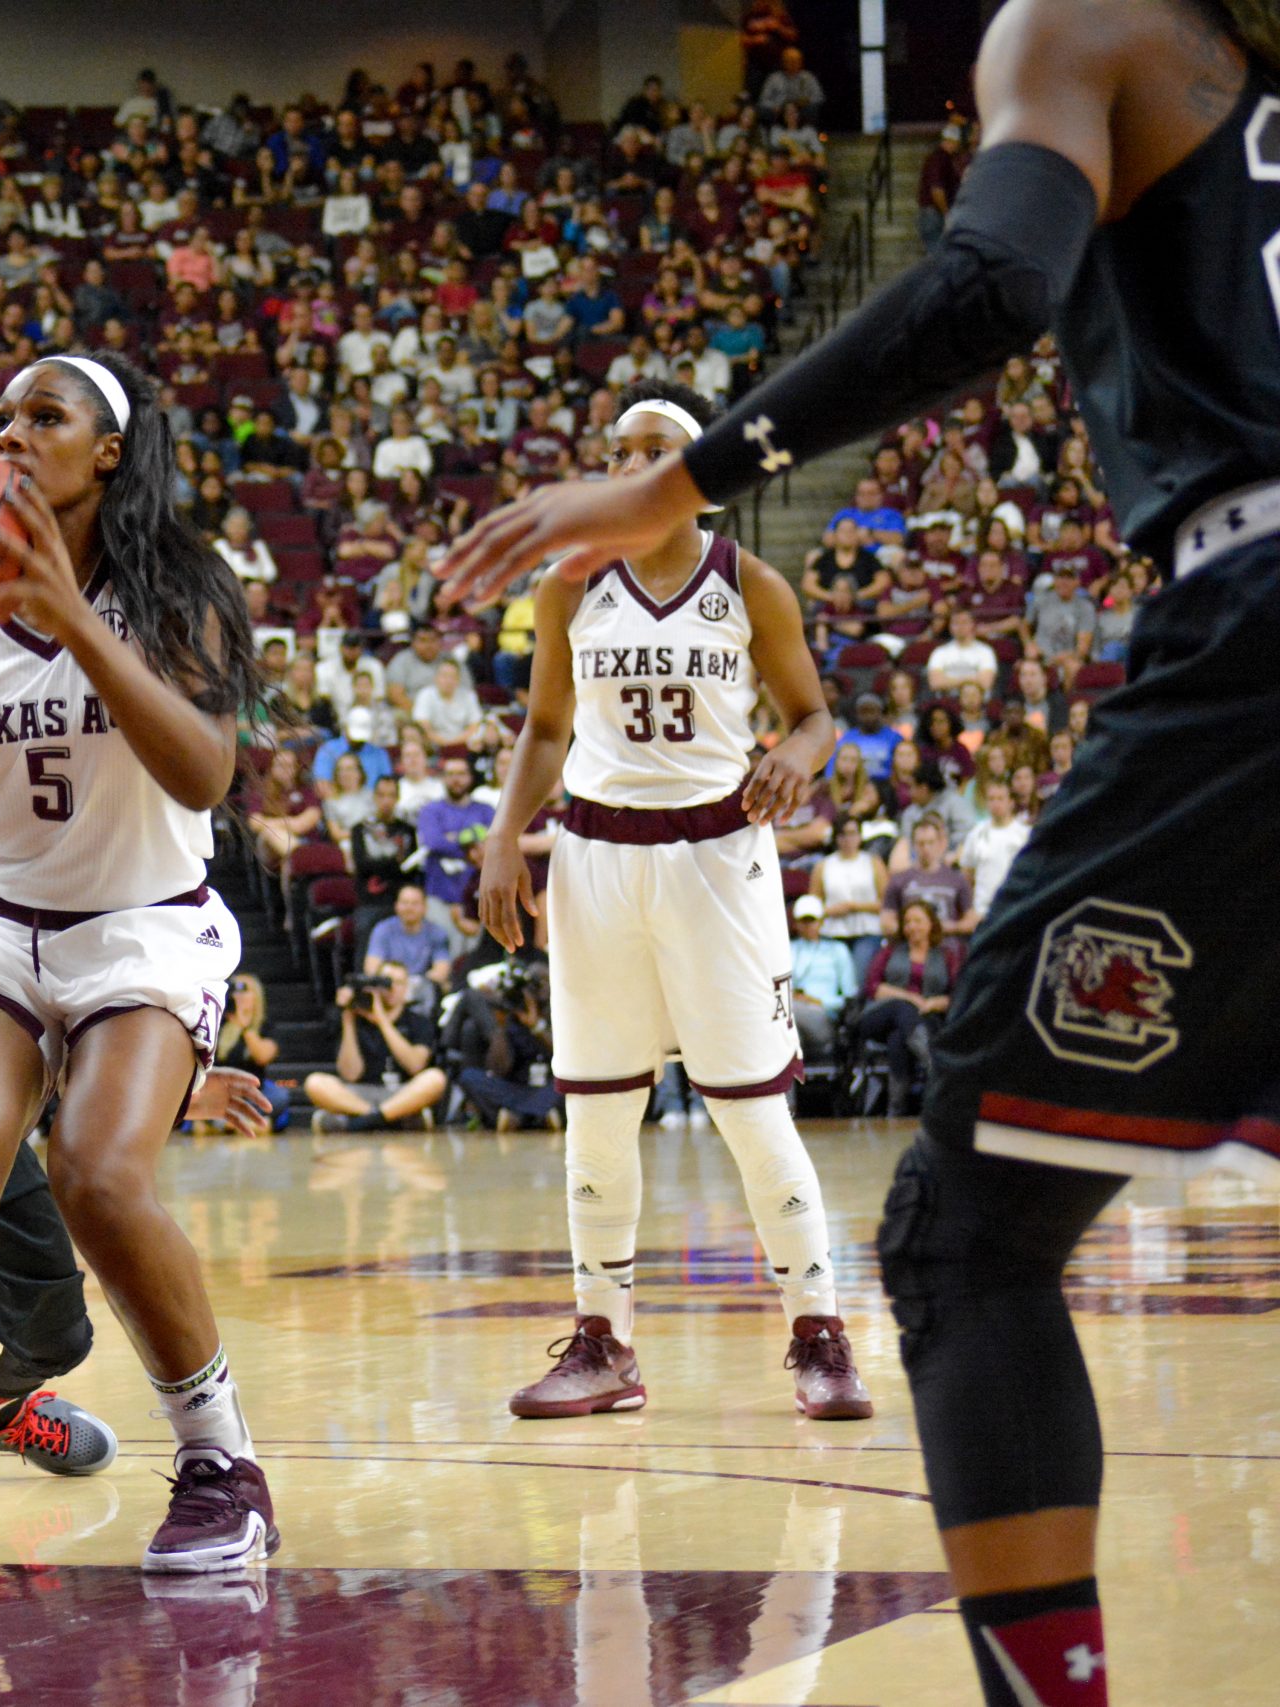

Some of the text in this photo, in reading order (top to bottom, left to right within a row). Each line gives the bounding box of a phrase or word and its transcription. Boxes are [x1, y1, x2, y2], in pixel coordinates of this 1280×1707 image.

[699, 592, 729, 621] SEC
[579, 646, 738, 683] TEXAS A&M
[620, 684, 696, 743] 33
[25, 746, 74, 822] 5
[196, 935, 224, 949] adidas
